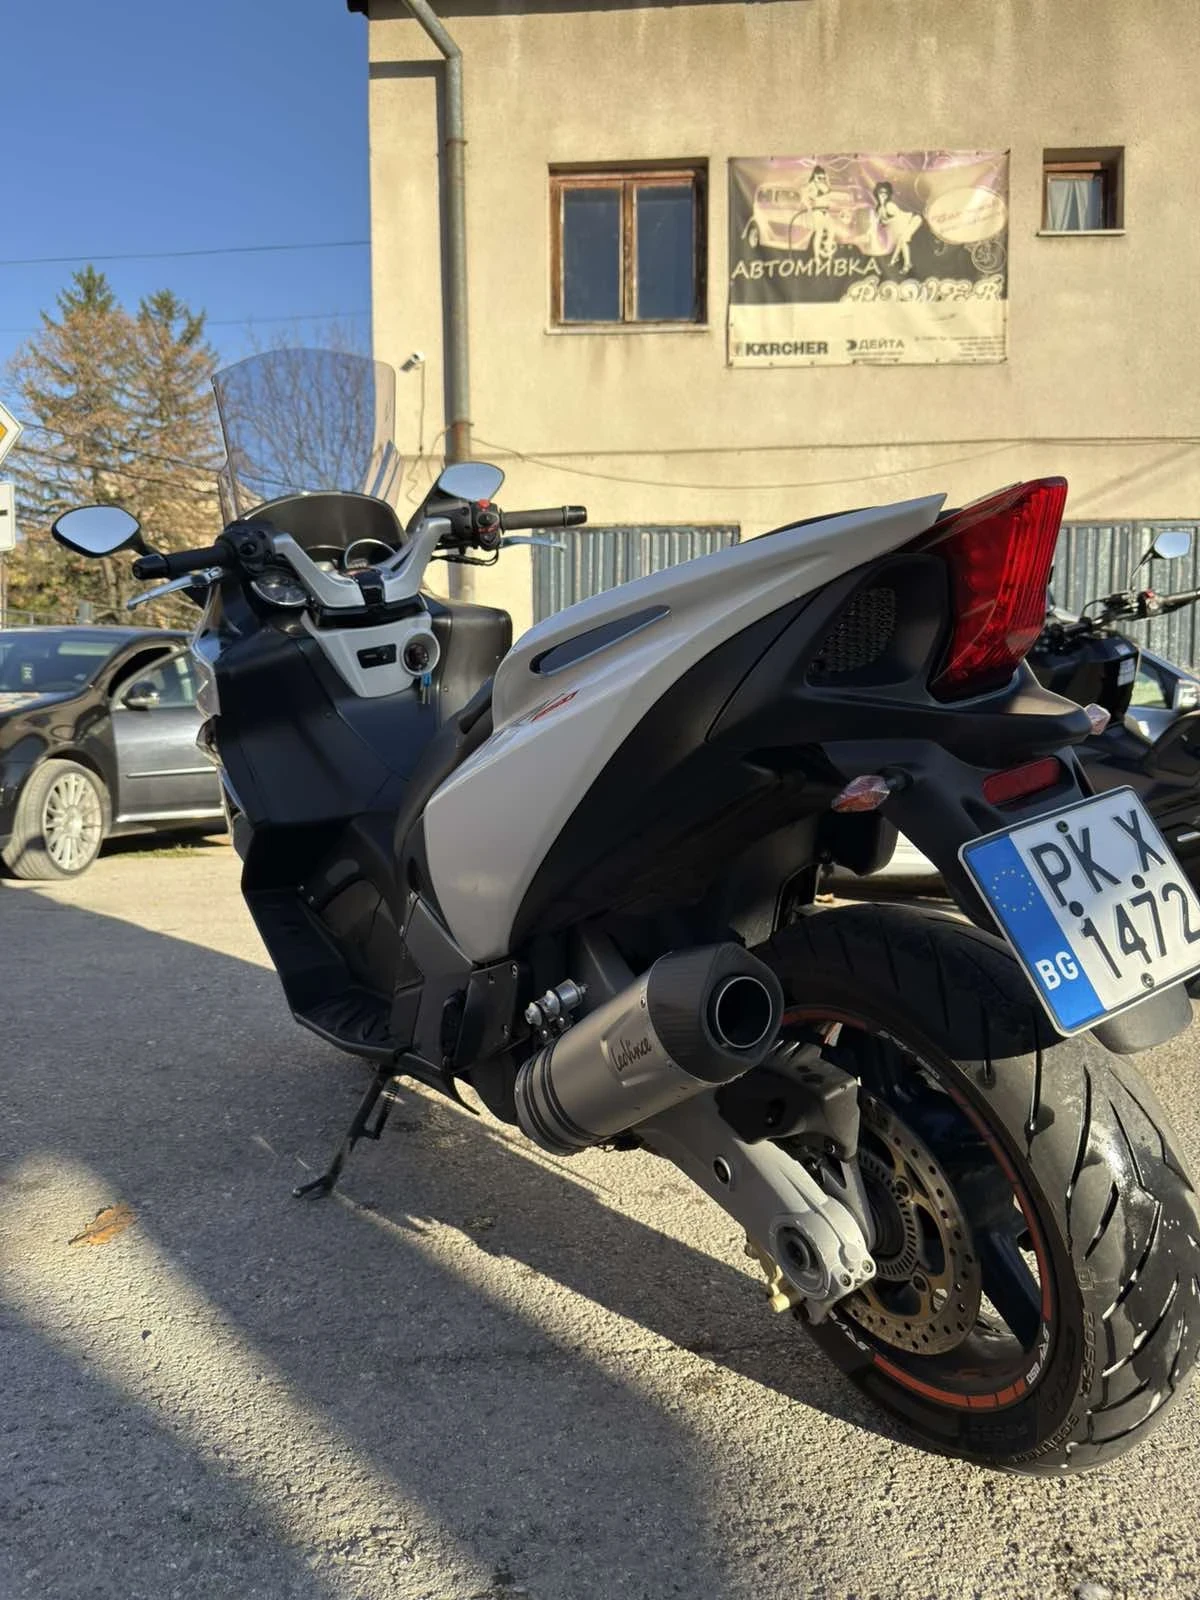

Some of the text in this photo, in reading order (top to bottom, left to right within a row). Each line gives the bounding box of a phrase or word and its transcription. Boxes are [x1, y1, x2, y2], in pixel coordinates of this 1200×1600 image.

[731, 258, 882, 279] АВТОМИВКА
[1029, 809, 1167, 907] PK X
[1080, 882, 1200, 980] 1472
[1035, 951, 1080, 991] BG
